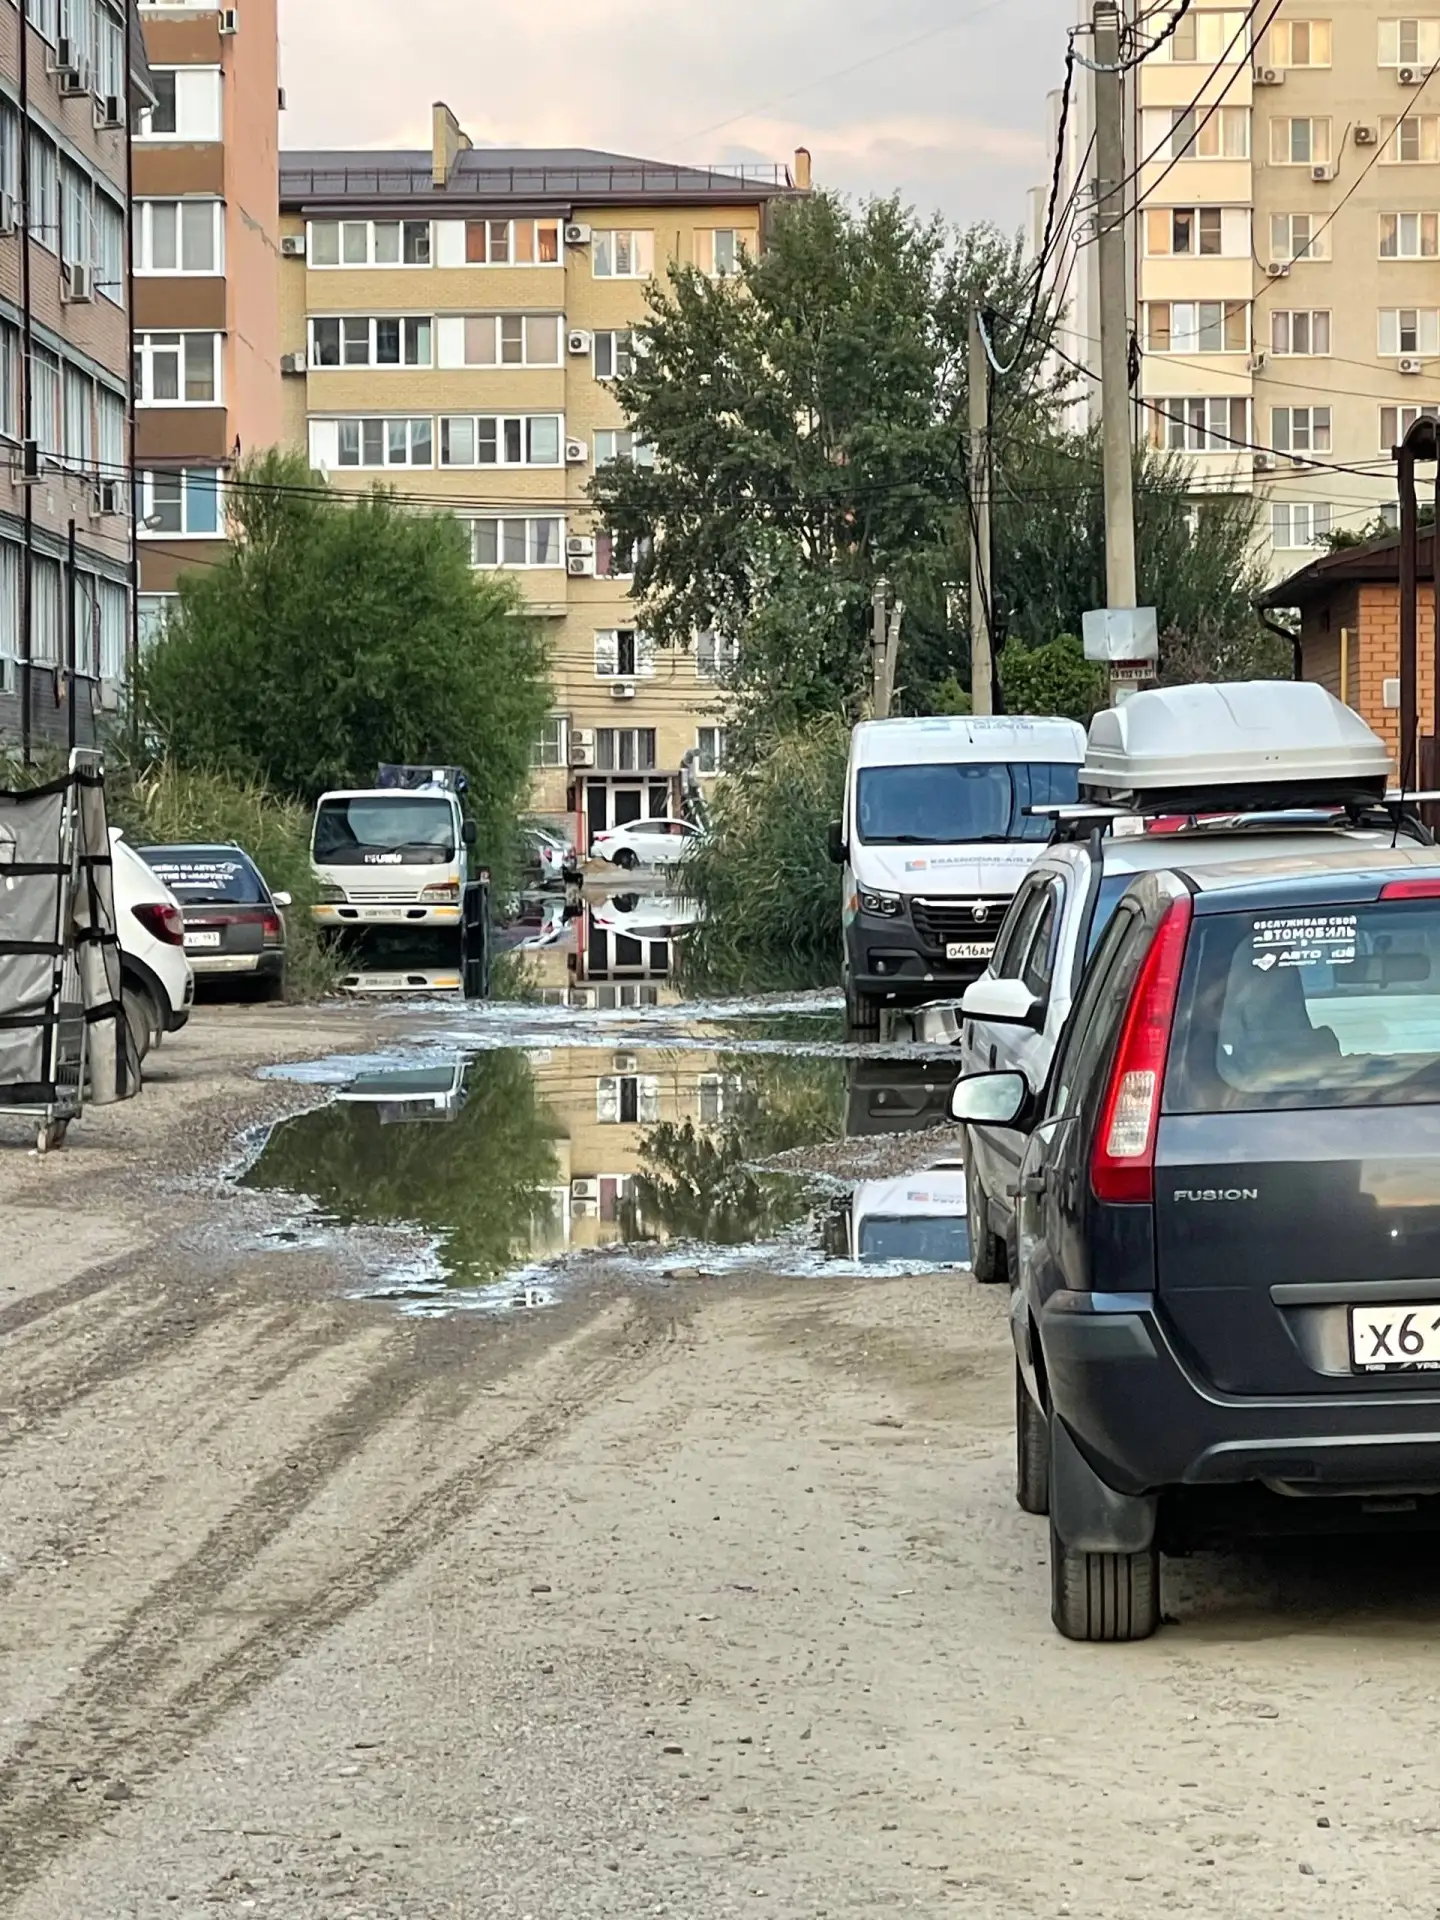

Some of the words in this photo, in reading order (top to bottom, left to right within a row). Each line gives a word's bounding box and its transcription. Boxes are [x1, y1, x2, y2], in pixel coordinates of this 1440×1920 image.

[1253, 917, 1327, 930] ОБСЛУЖИВАЮ
[1329, 915, 1357, 925] СВОЙ
[1174, 1189, 1258, 1202] FUSION
